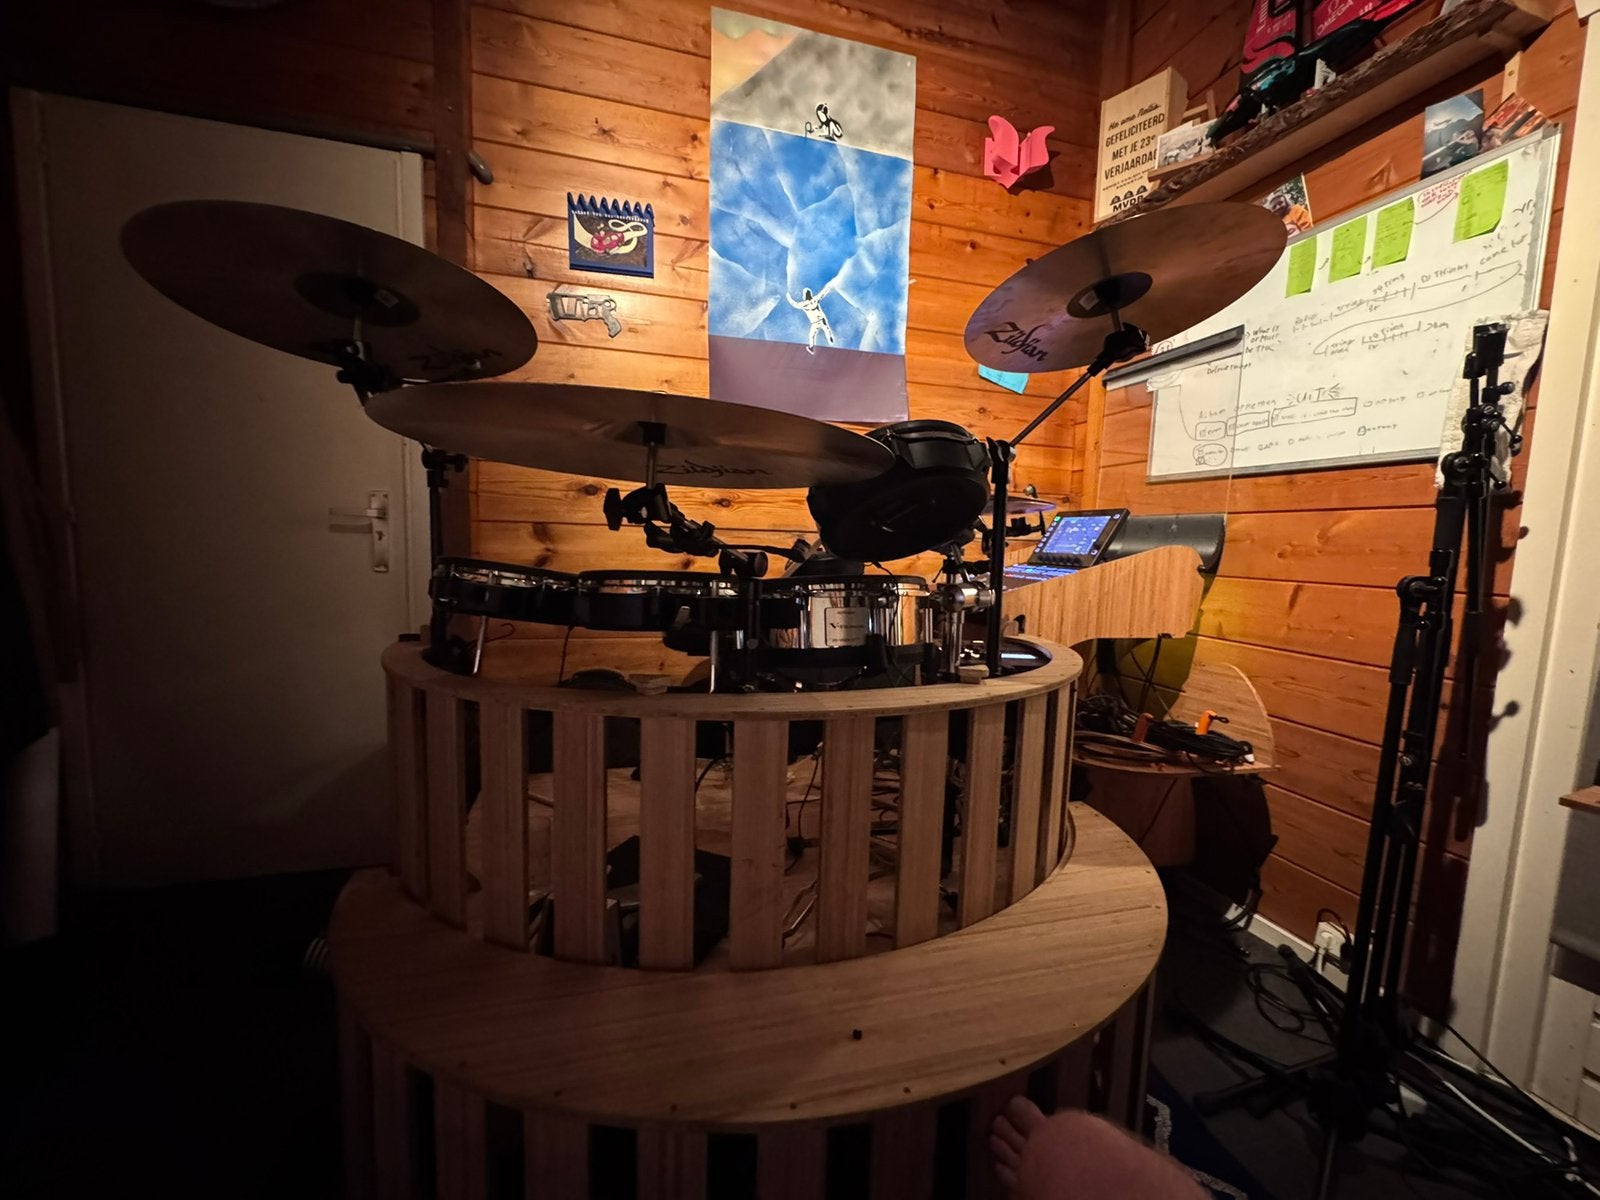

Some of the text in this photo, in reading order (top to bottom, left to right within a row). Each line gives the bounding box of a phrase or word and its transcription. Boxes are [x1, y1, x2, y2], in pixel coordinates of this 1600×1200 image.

[1105, 113, 1165, 148] GEFELICITEERD
[1112, 145, 1128, 161] MET
[1129, 141, 1138, 152] JE
[984, 321, 1048, 362] Zildjian
[655, 460, 774, 478] Zildjian
